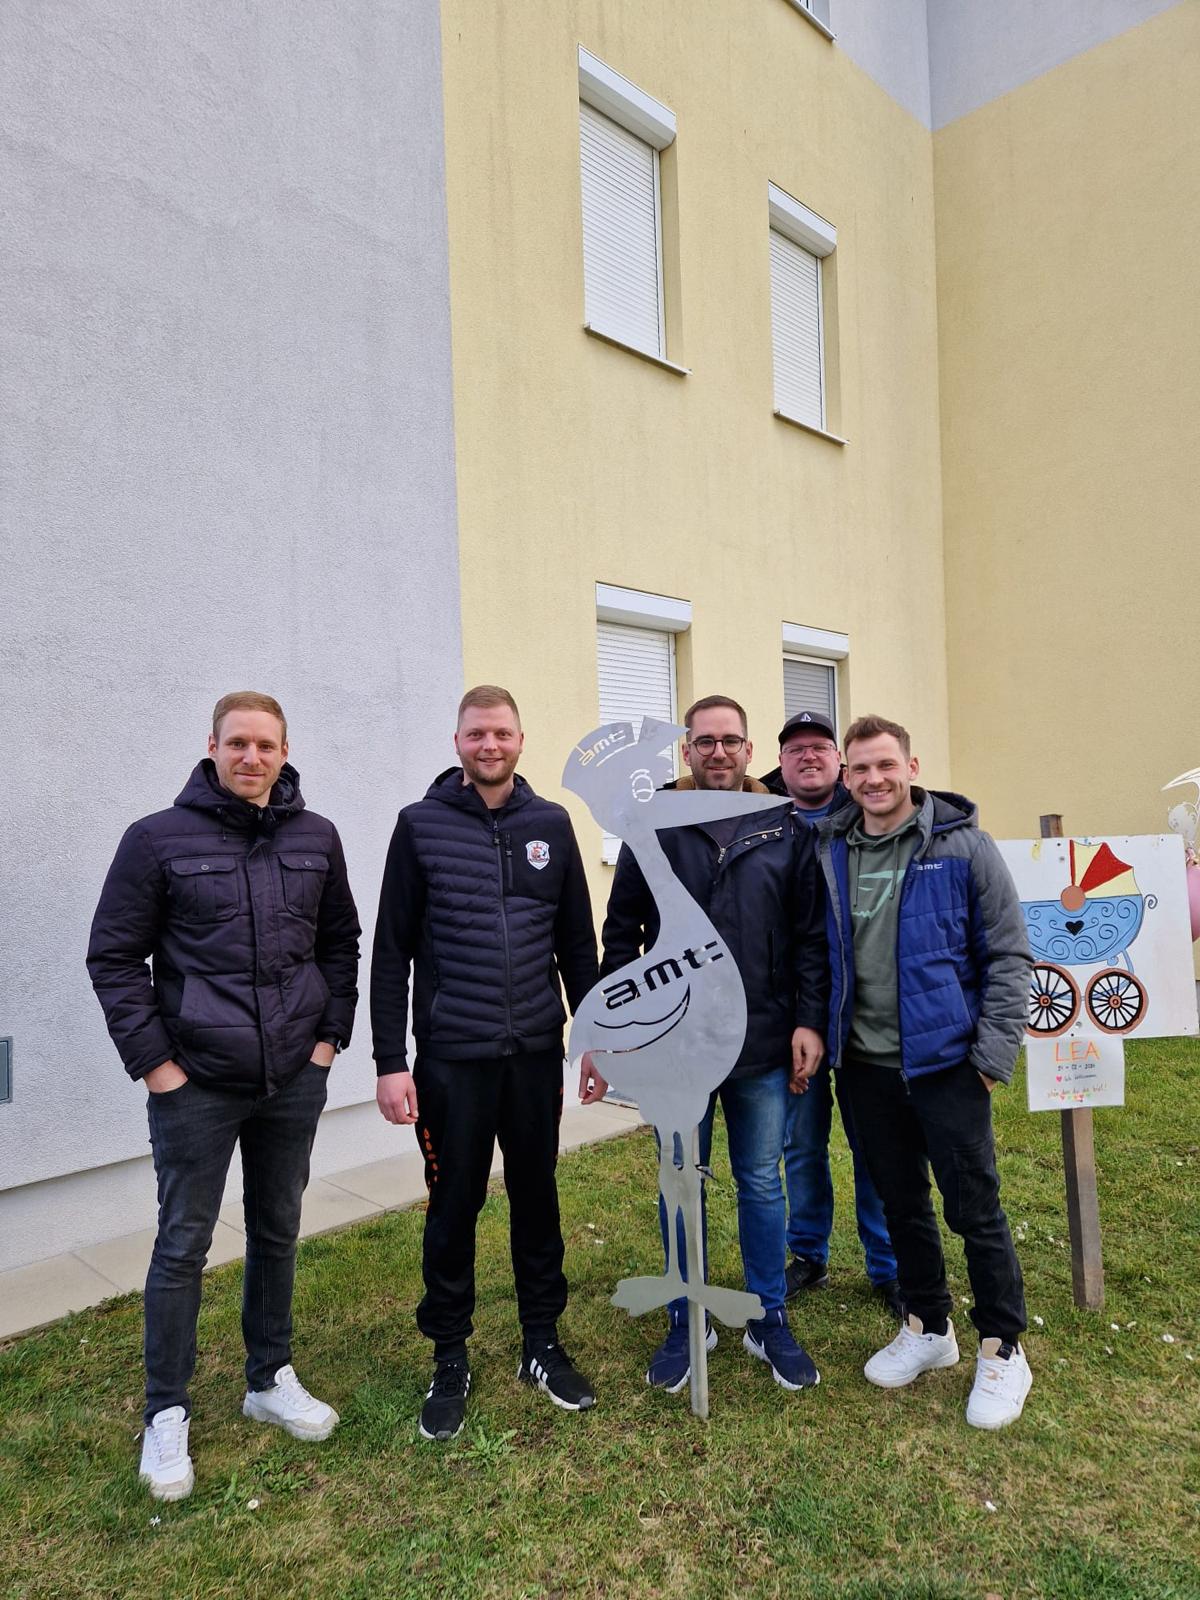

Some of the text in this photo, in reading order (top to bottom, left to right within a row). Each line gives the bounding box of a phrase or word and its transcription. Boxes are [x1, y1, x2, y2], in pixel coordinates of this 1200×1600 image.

[579, 730, 626, 766] amt
[916, 863, 944, 871] amt
[601, 940, 724, 1010] amt
[1055, 1040, 1100, 1062] LEA
